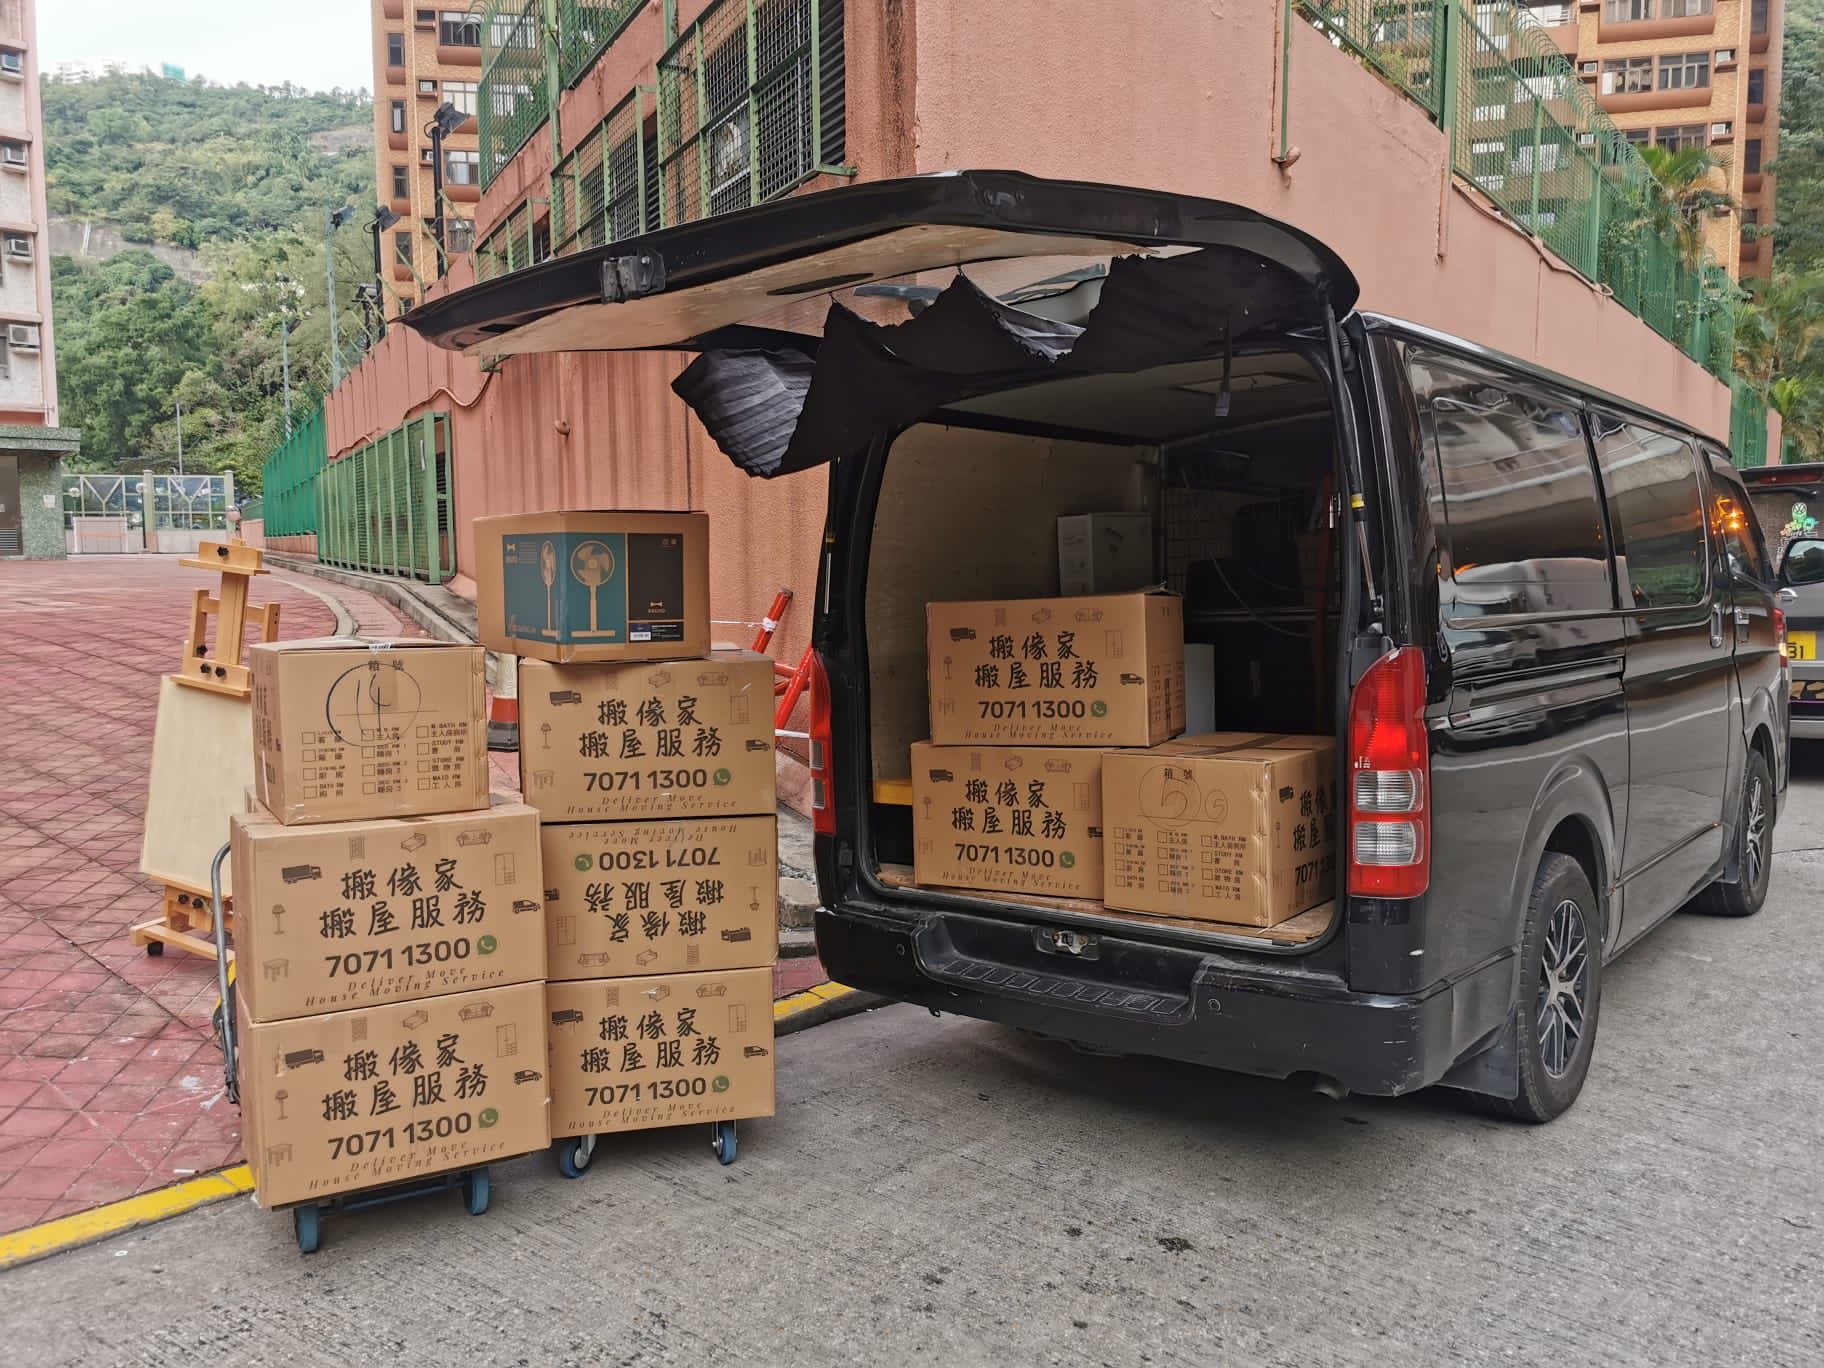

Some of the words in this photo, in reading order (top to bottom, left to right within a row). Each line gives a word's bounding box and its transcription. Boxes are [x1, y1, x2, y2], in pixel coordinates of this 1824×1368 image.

[989, 631, 1080, 660] 搬傢家
[975, 660, 1098, 689] 搬屋服務
[598, 696, 702, 727] 搬傢家
[978, 701, 1025, 718] 7071
[1032, 700, 1085, 718] 1300
[579, 726, 722, 759] 搬屋服務
[583, 771, 640, 791] 7071
[648, 769, 707, 789] 1300
[966, 779, 1048, 808] 搬傢家
[952, 806, 1067, 839] 搬屋服務
[599, 850, 658, 870] 1300
[666, 847, 720, 867] 7071
[955, 843, 999, 863] 7071
[1005, 847, 1054, 867] 1300
[341, 858, 463, 900] 搬傢家
[584, 880, 724, 912] 搬屋服務
[319, 890, 487, 938] 搬屋服務
[604, 911, 707, 942] 搬傢家
[325, 948, 393, 977] 7071
[401, 938, 470, 966] 1300
[305, 992, 359, 1006] House
[370, 981, 431, 995] Moving
[442, 969, 504, 985] Service
[349, 976, 413, 991] Deliver
[426, 967, 465, 979] Move
[599, 1008, 702, 1041] 搬傢家
[344, 1034, 464, 1081] 搬傢家
[580, 1036, 721, 1073] 搬屋服務
[322, 1064, 488, 1120] 搬屋服務
[584, 1084, 641, 1106] 7071
[648, 1077, 706, 1100] 1300
[568, 1120, 610, 1129] House
[622, 1113, 672, 1124] Moving
[683, 1106, 735, 1117] Service
[603, 1106, 658, 1118] Deliver
[668, 1103, 702, 1111] Move
[328, 1128, 394, 1160] 7071
[403, 1112, 472, 1144] 1300
[309, 1173, 360, 1190] House
[372, 1159, 432, 1175] Moving
[443, 1142, 505, 1160] Service
[351, 1156, 416, 1172] Deliver
[427, 1141, 466, 1156] Move
